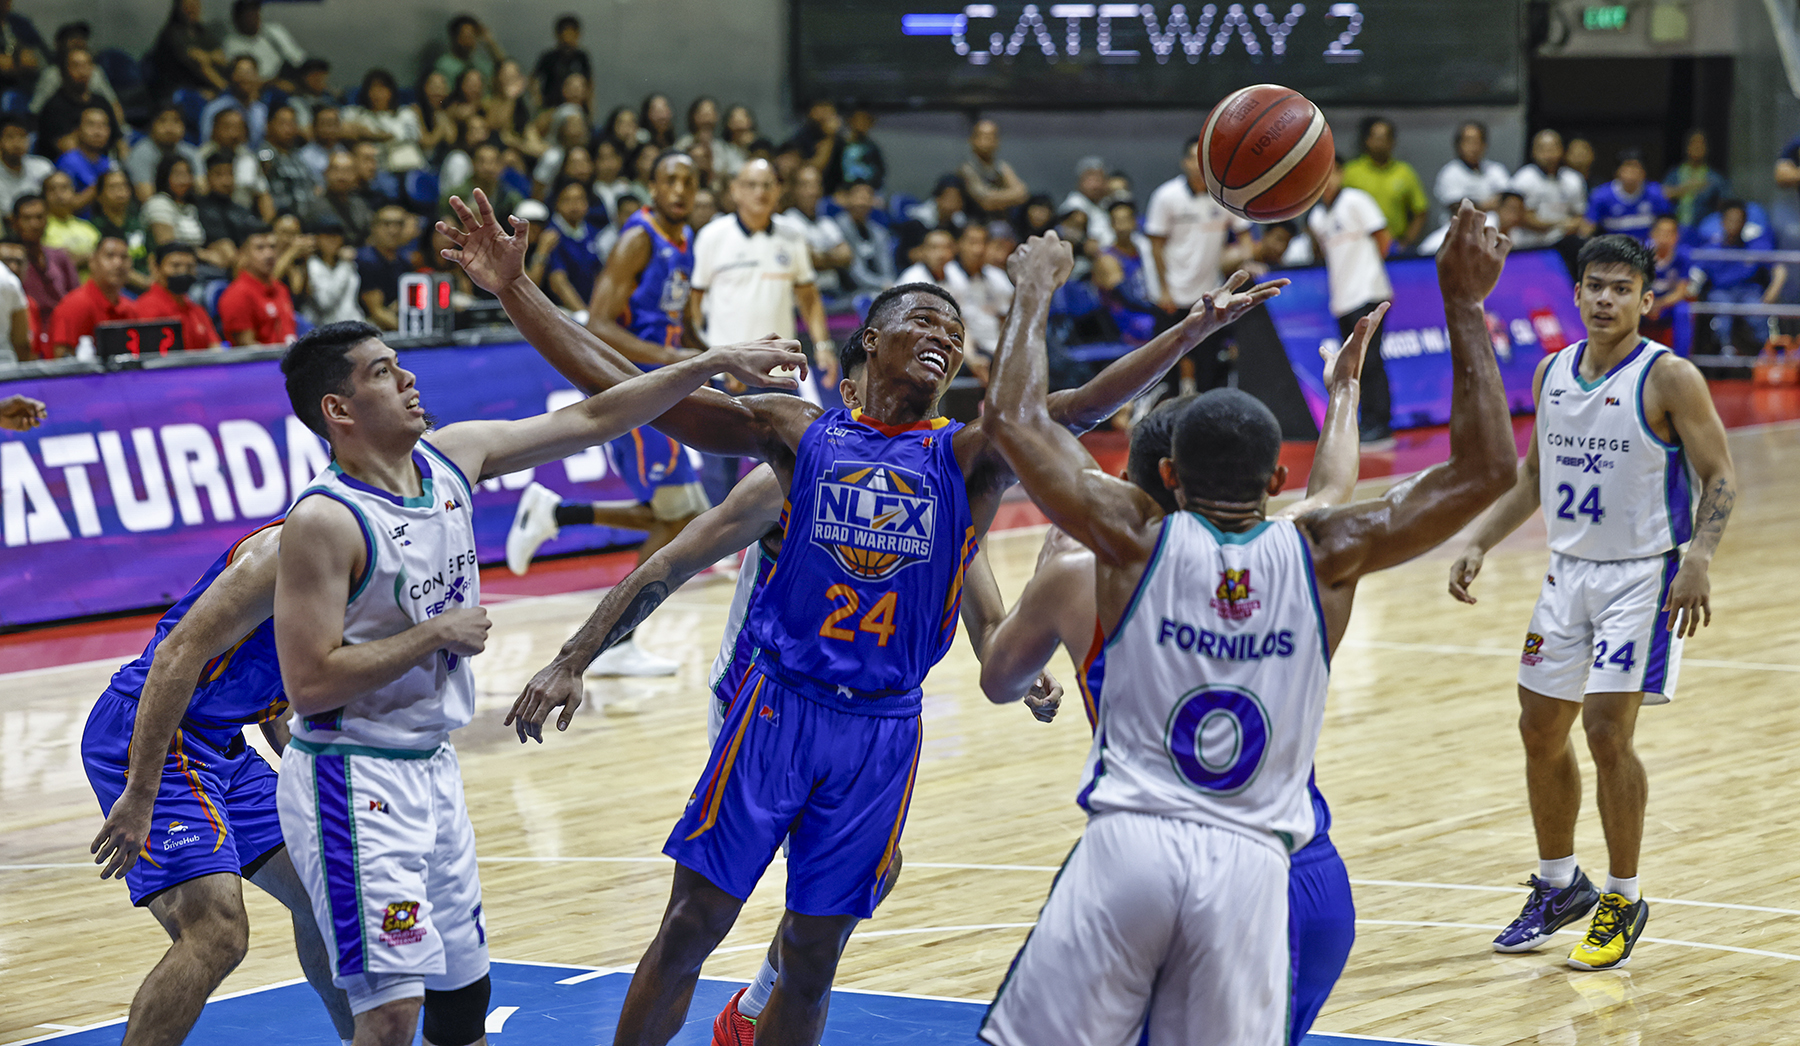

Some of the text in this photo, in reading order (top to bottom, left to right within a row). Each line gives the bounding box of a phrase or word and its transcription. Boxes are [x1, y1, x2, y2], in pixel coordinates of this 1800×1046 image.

[951, 3, 1364, 64] GATEWAY 2
[1251, 109, 1297, 156] molten
[1547, 433, 1630, 452] CONVERGE
[817, 484, 932, 538] NLEX
[1556, 481, 1606, 525] 24
[814, 523, 930, 557] ROAD WARRIORS
[819, 583, 898, 647] 24
[1157, 617, 1296, 661] FORNILOS
[1592, 640, 1637, 674] 24
[1164, 683, 1272, 798] 0
[164, 835, 200, 850] DriveHub
